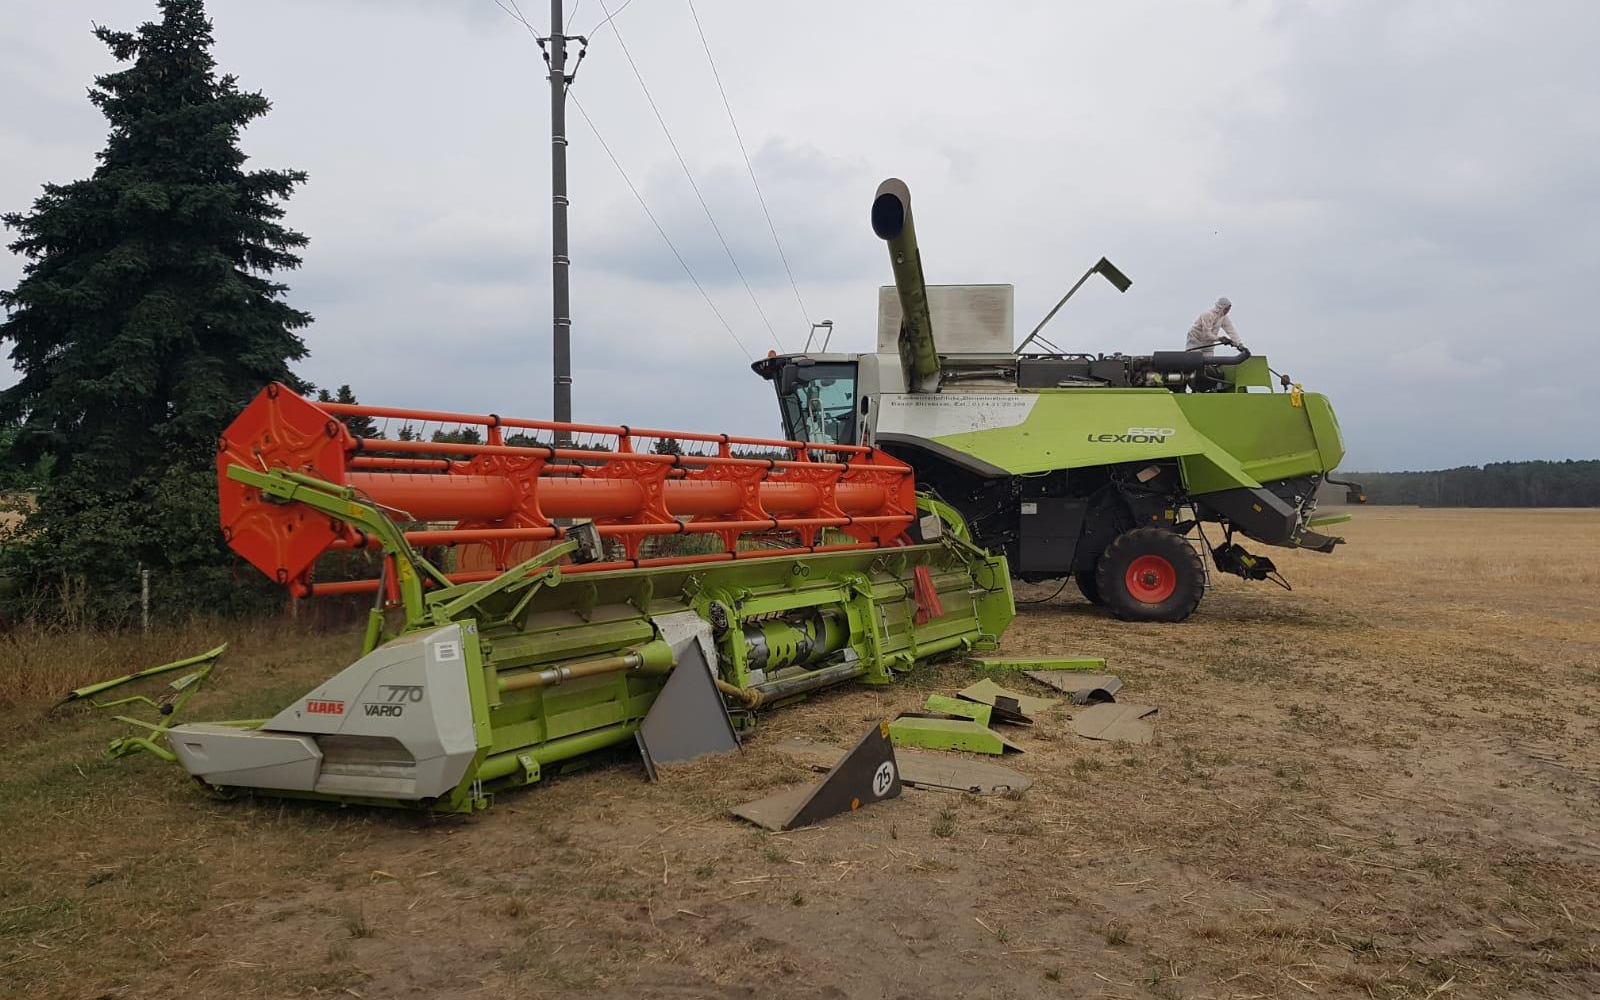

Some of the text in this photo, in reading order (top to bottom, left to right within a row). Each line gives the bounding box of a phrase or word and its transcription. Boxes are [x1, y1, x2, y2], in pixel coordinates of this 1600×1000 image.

[1127, 427, 1176, 436] 650
[1087, 433, 1166, 444] LEXION
[387, 686, 424, 703] 770
[307, 701, 345, 714] CLAAS
[364, 704, 403, 717] VARIO
[876, 765, 891, 793] 25
